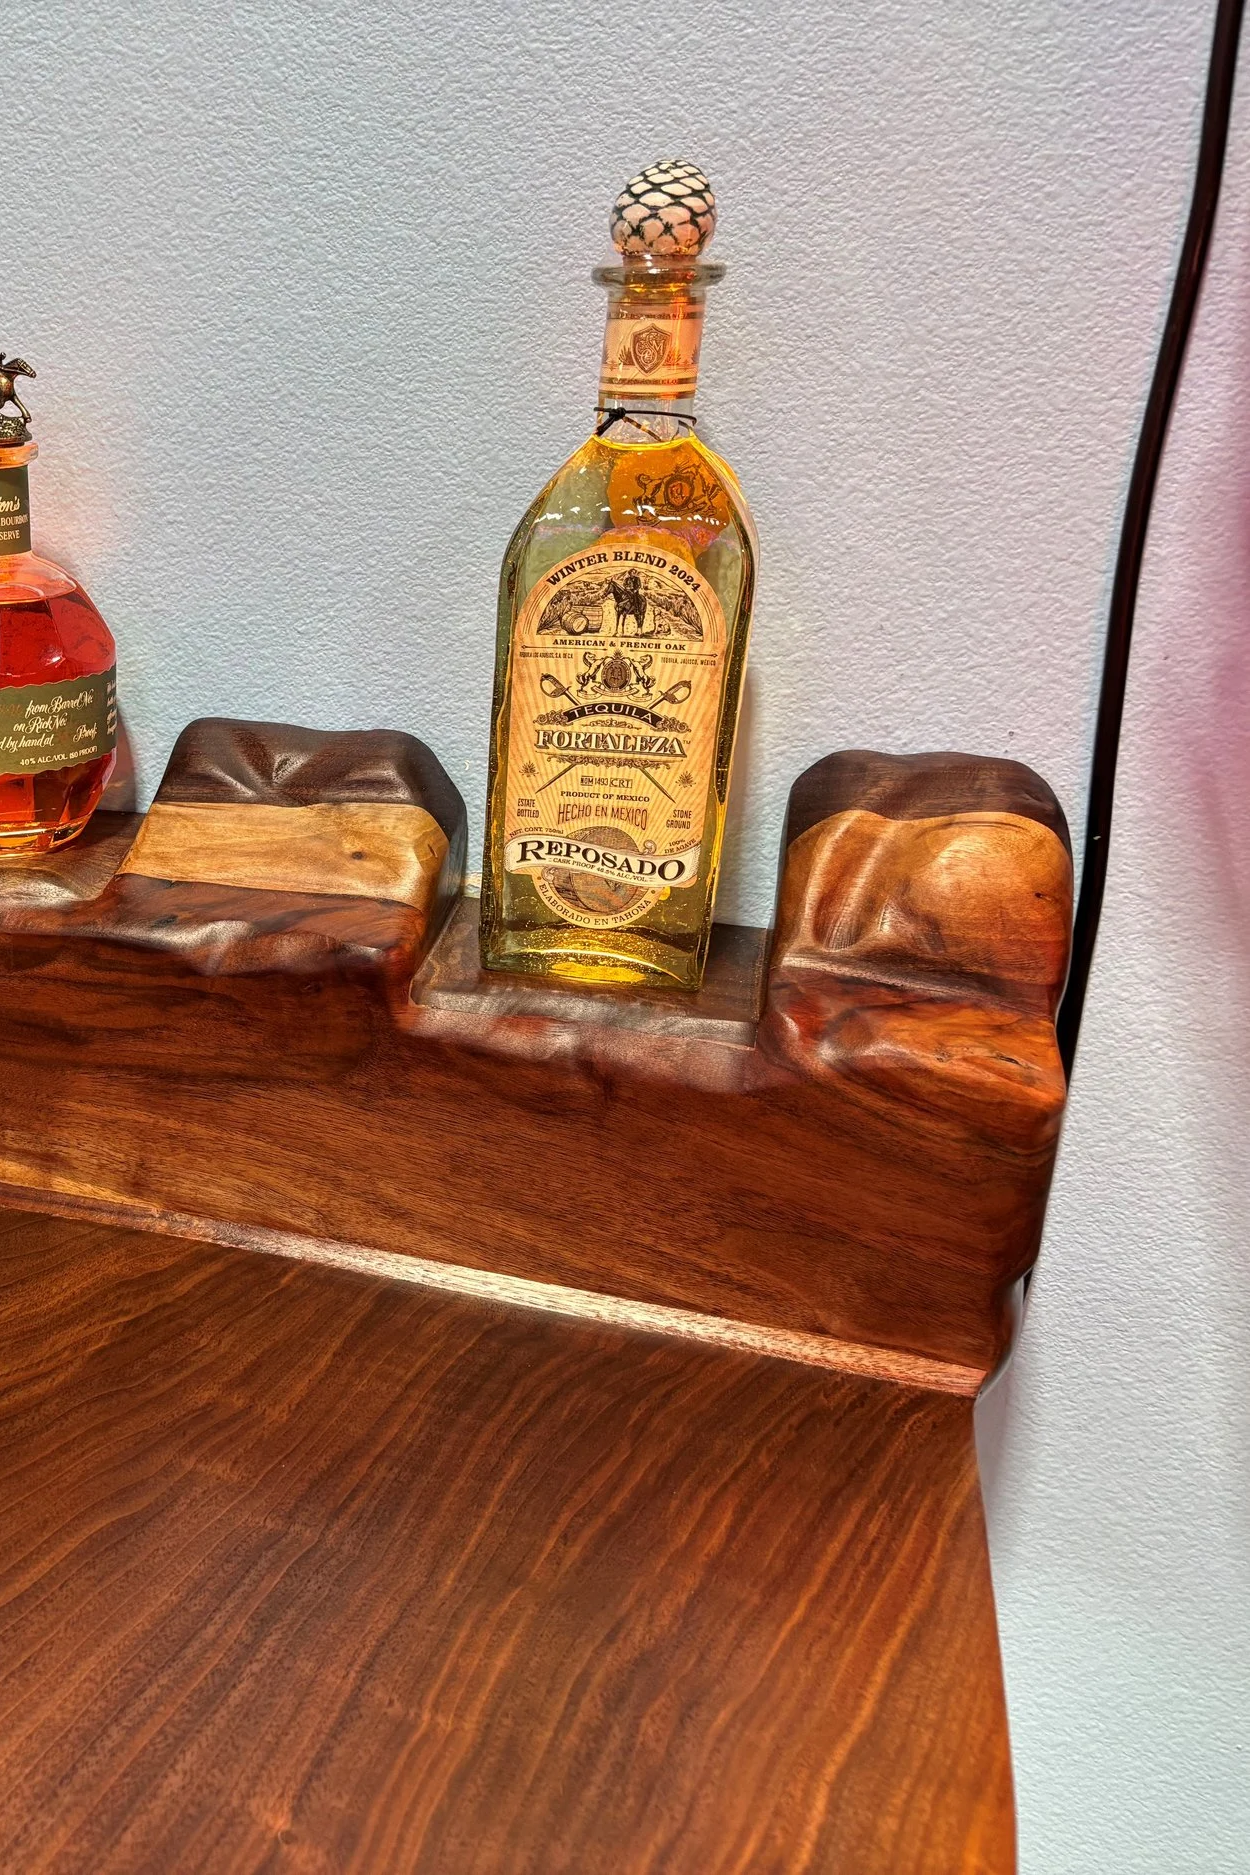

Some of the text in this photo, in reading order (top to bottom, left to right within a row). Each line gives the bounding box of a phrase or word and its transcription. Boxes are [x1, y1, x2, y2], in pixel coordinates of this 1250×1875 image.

[546, 551, 701, 593] WINTER BLEND 2024
[553, 638, 605, 647] AMERICAN
[620, 641, 661, 650] FRENCH
[665, 643, 686, 651] OAK
[25, 700, 48, 718] from
[48, 692, 83, 714] Barrel
[570, 703, 653, 724] TEQUILA
[13, 723, 26, 733] on
[25, 716, 52, 734] Rick
[6, 736, 19, 753] by
[18, 733, 45, 747] hand
[44, 734, 55, 747] at
[535, 730, 687, 758] FORTALEZA
[20, 757, 36, 766] 40%
[594, 777, 608, 786] 1493
[610, 778, 630, 788] CRT
[561, 790, 600, 799] PRODUCT
[518, 798, 535, 807] ESTATE
[517, 808, 539, 818] BOTTLED
[558, 803, 648, 830] HECHO EN MEXICO
[673, 809, 692, 819] STONE
[545, 827, 564, 835] 750ml
[666, 820, 690, 829] GROUND
[675, 838, 696, 853] AGAVE
[516, 840, 685, 881] REPOSADO
[553, 857, 571, 865] CASK
[572, 860, 596, 870] PROOF
[539, 883, 591, 924] ELABORADO
[612, 899, 651, 924] TAHONA
